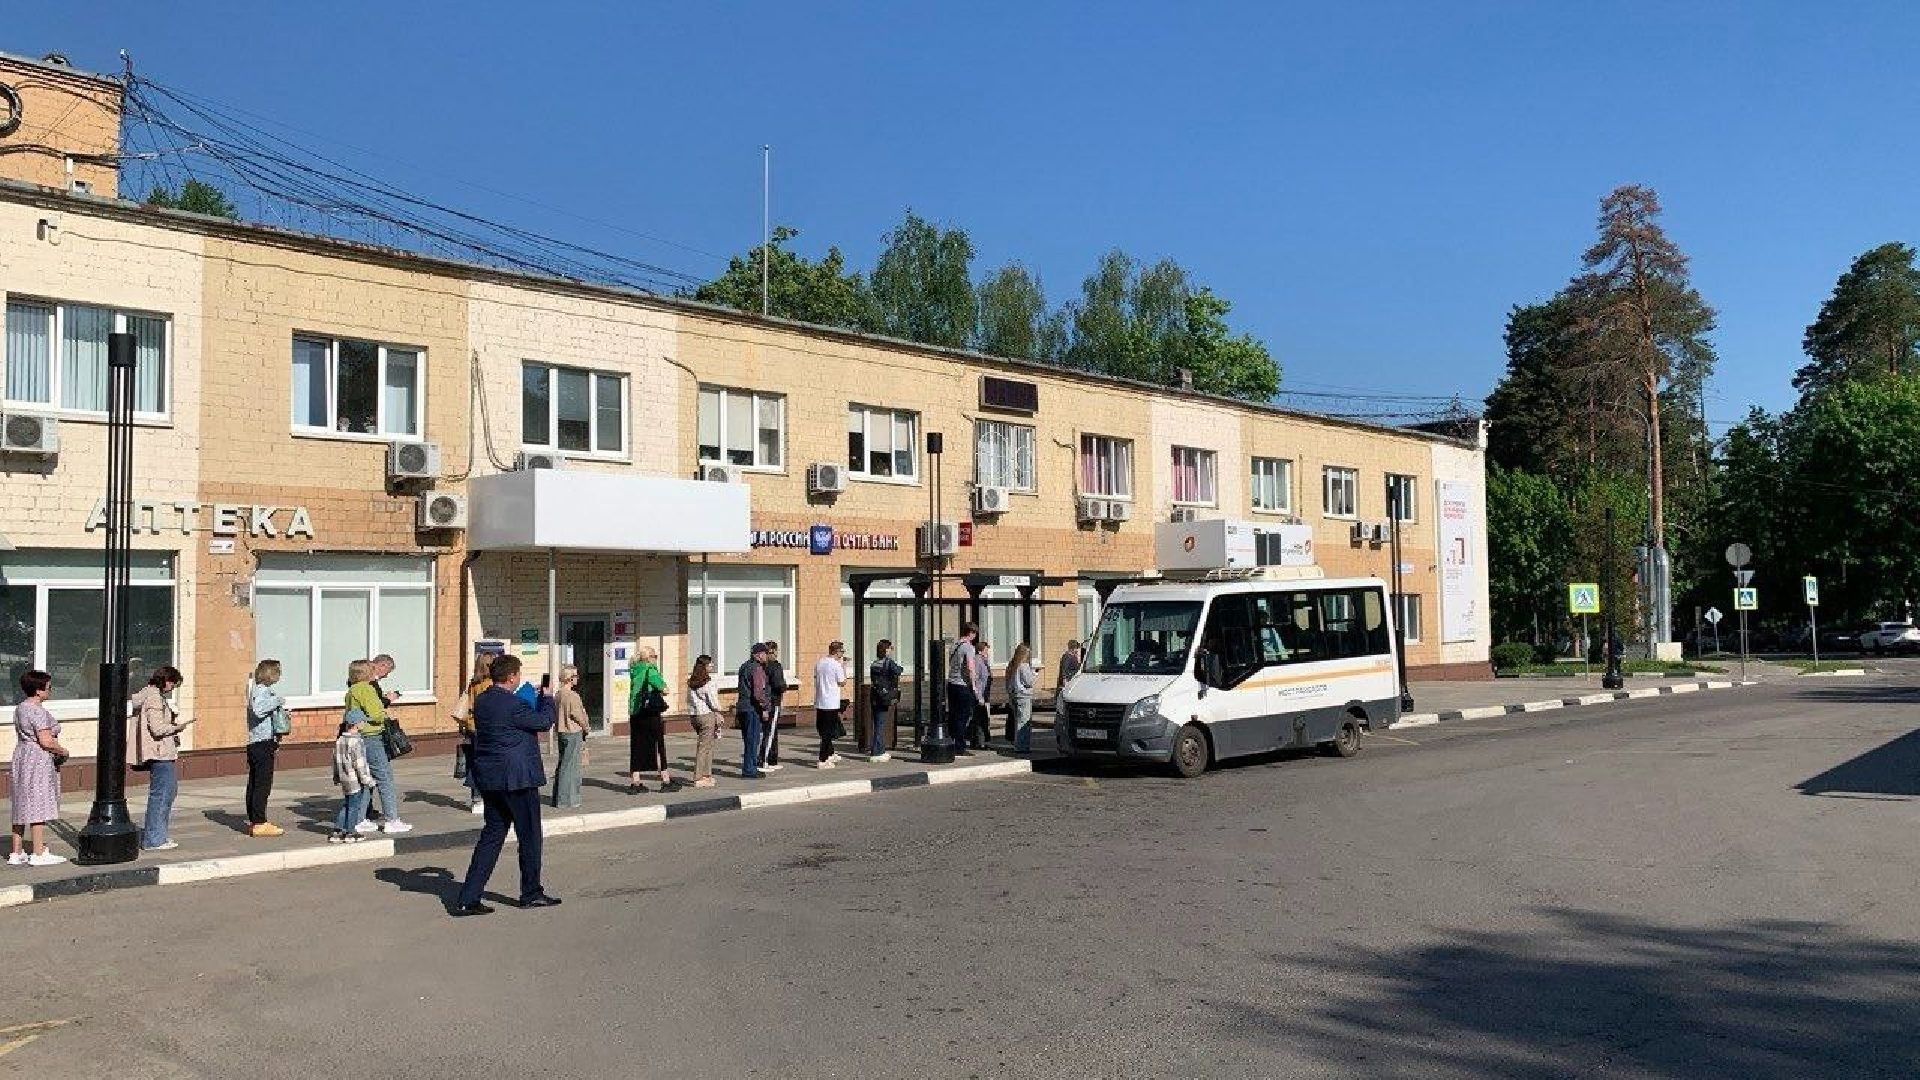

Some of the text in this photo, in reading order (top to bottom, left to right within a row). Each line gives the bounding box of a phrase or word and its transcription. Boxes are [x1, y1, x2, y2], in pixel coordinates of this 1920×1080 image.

[85, 498, 313, 537] АПТЕКА
[770, 531, 811, 547] РОССИИ
[833, 533, 898, 549] ПОЧТА БАНК
